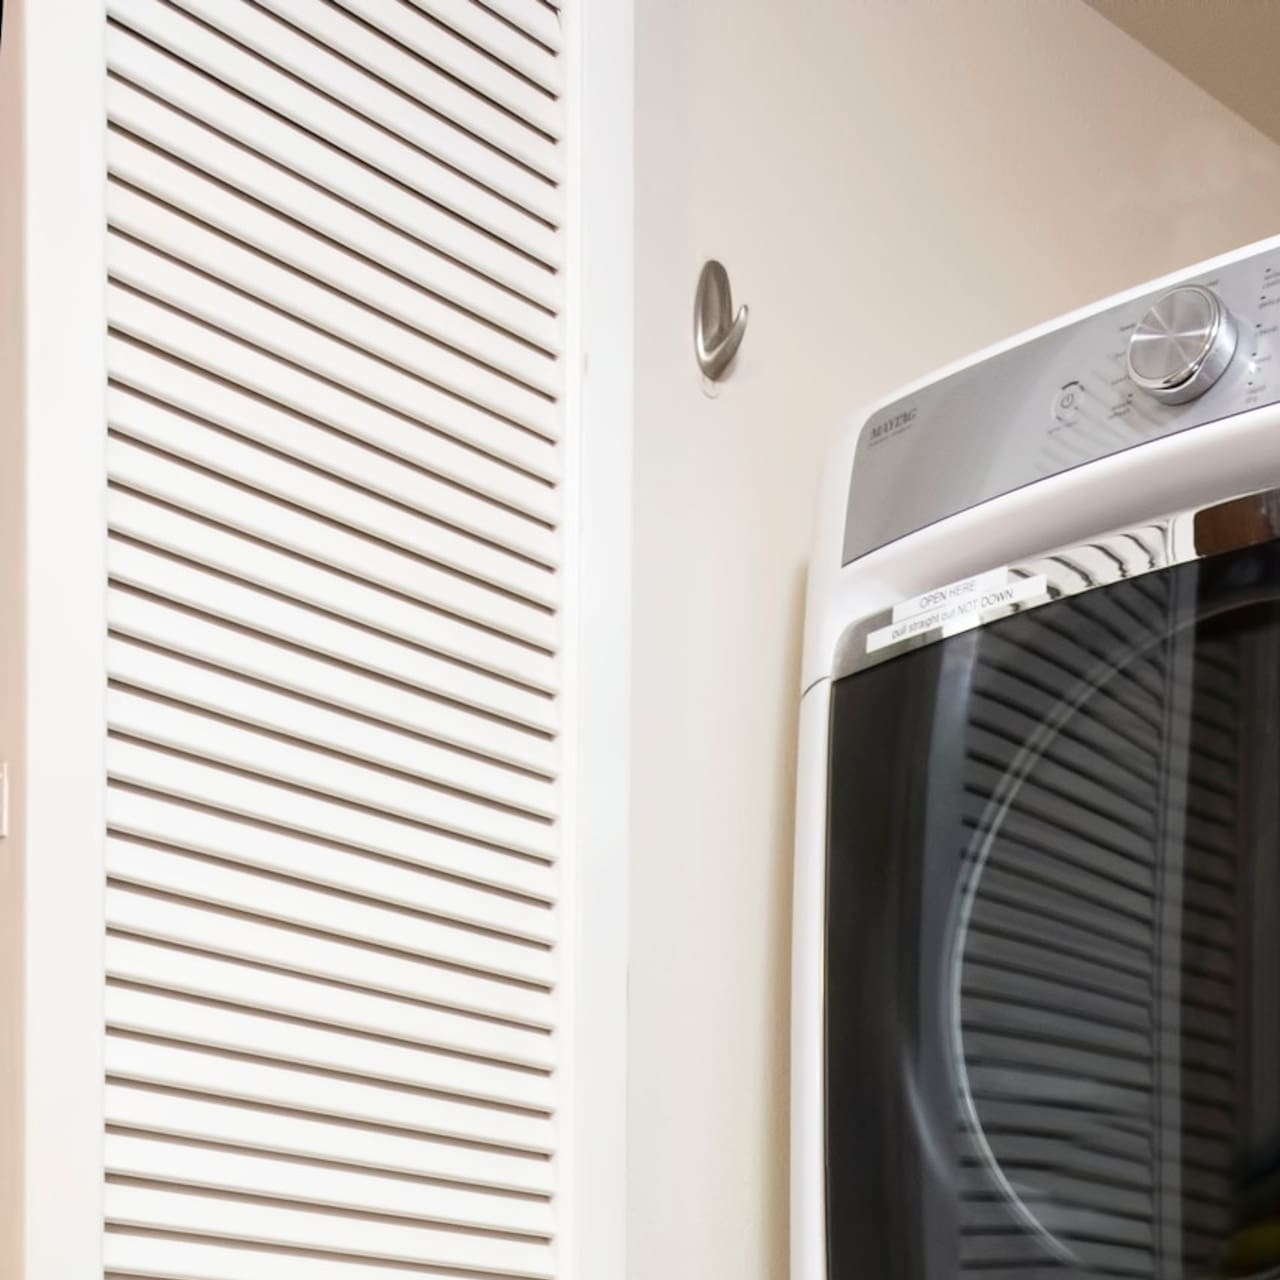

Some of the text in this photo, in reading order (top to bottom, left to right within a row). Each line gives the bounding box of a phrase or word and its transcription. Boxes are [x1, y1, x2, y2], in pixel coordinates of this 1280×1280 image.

[919, 581, 976, 609] OPEN HERE
[957, 599, 977, 614] NOT
[981, 590, 1013, 608] DOWN
